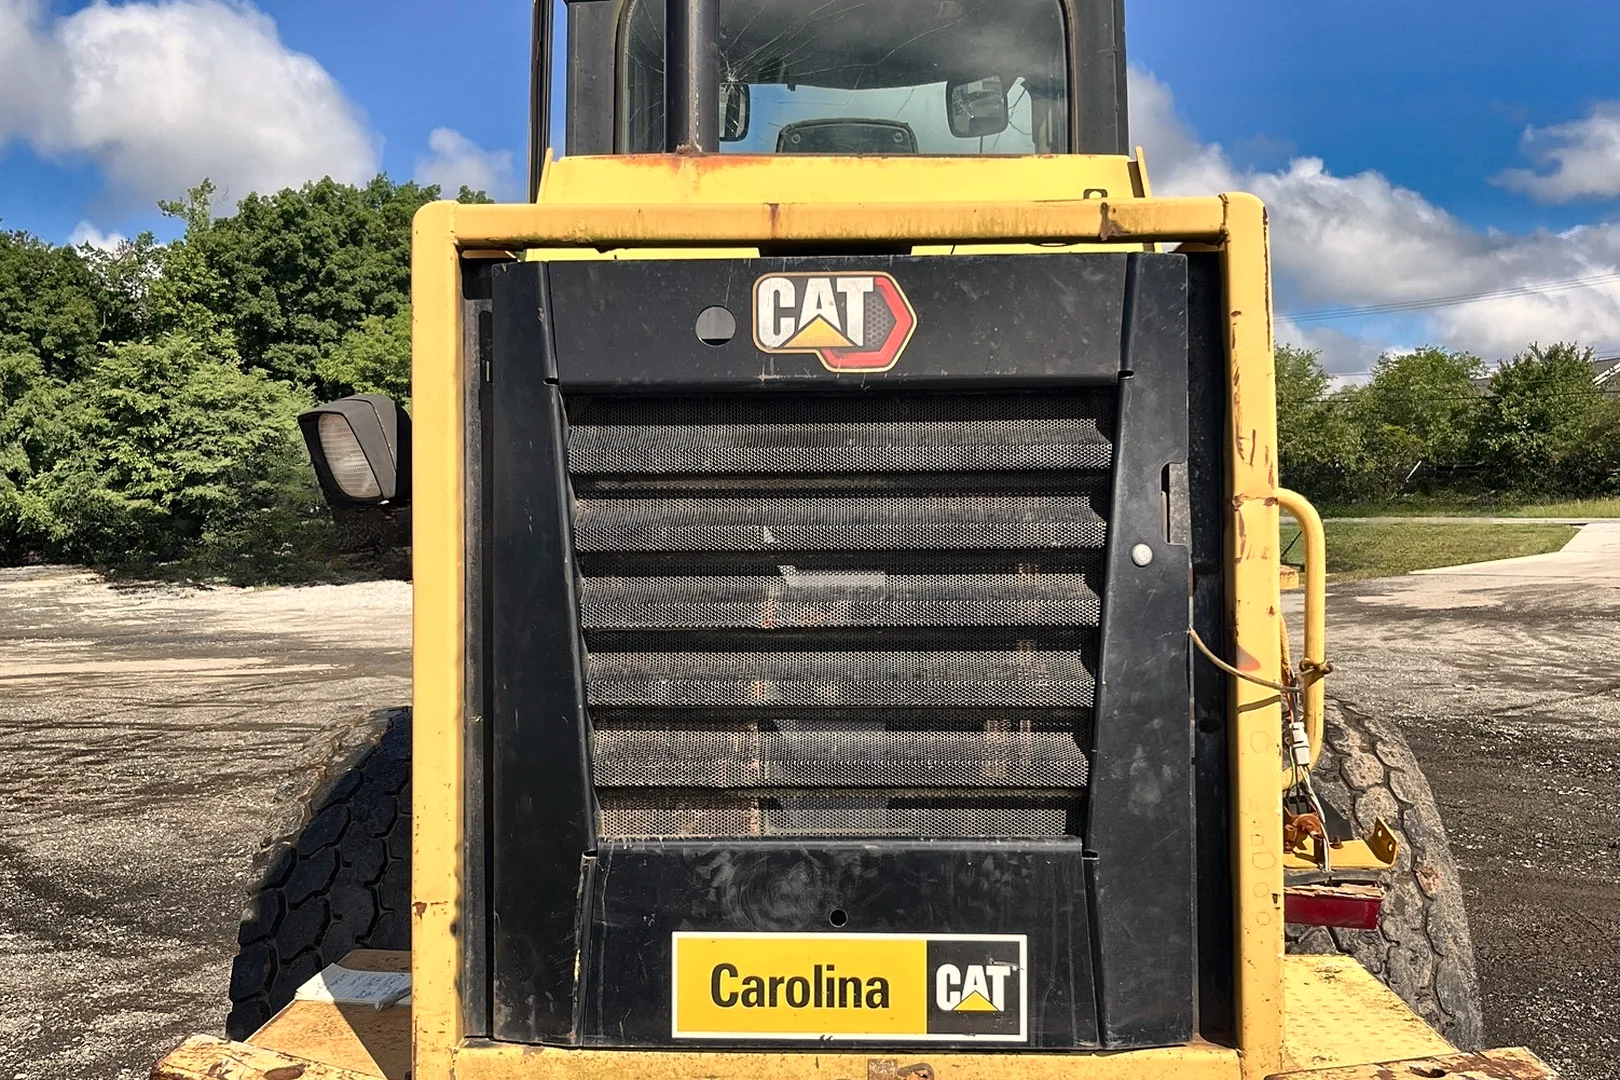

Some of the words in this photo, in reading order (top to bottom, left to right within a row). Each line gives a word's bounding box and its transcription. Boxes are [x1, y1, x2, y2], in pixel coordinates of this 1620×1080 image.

[757, 277, 873, 347] CAT
[710, 963, 890, 1009] Carolina
[936, 963, 1011, 1012] CAT
